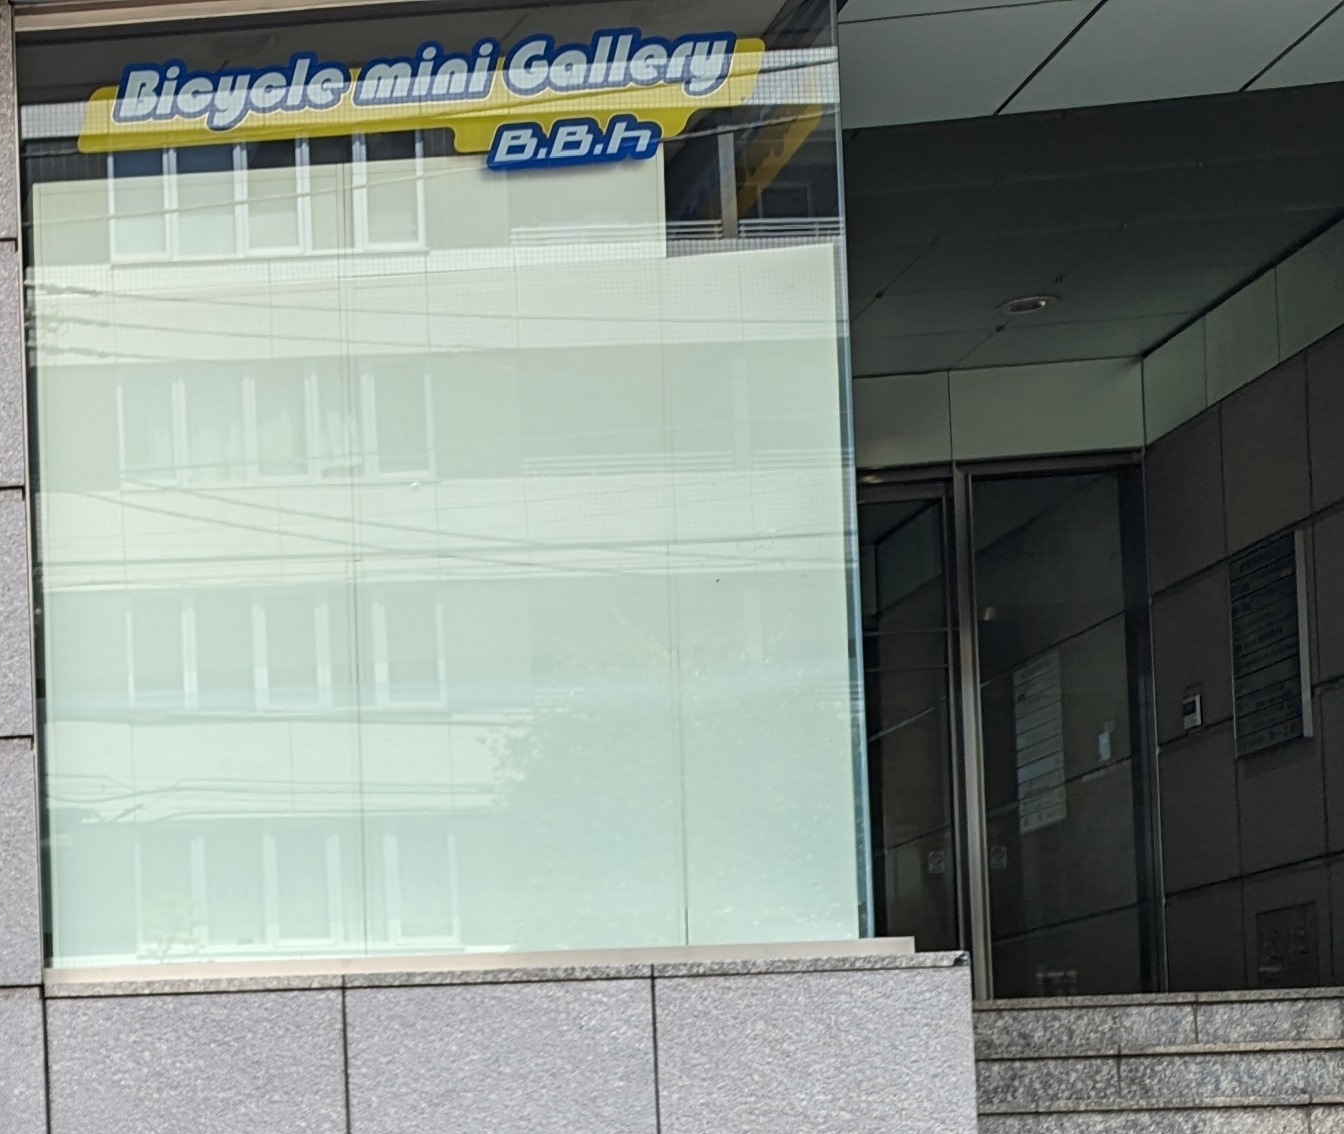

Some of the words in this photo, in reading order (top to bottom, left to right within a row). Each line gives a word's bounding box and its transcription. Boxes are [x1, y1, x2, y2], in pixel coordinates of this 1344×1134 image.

[118, 58, 345, 129] Bicycle
[358, 42, 495, 100] mini
[508, 34, 728, 92] Gallery
